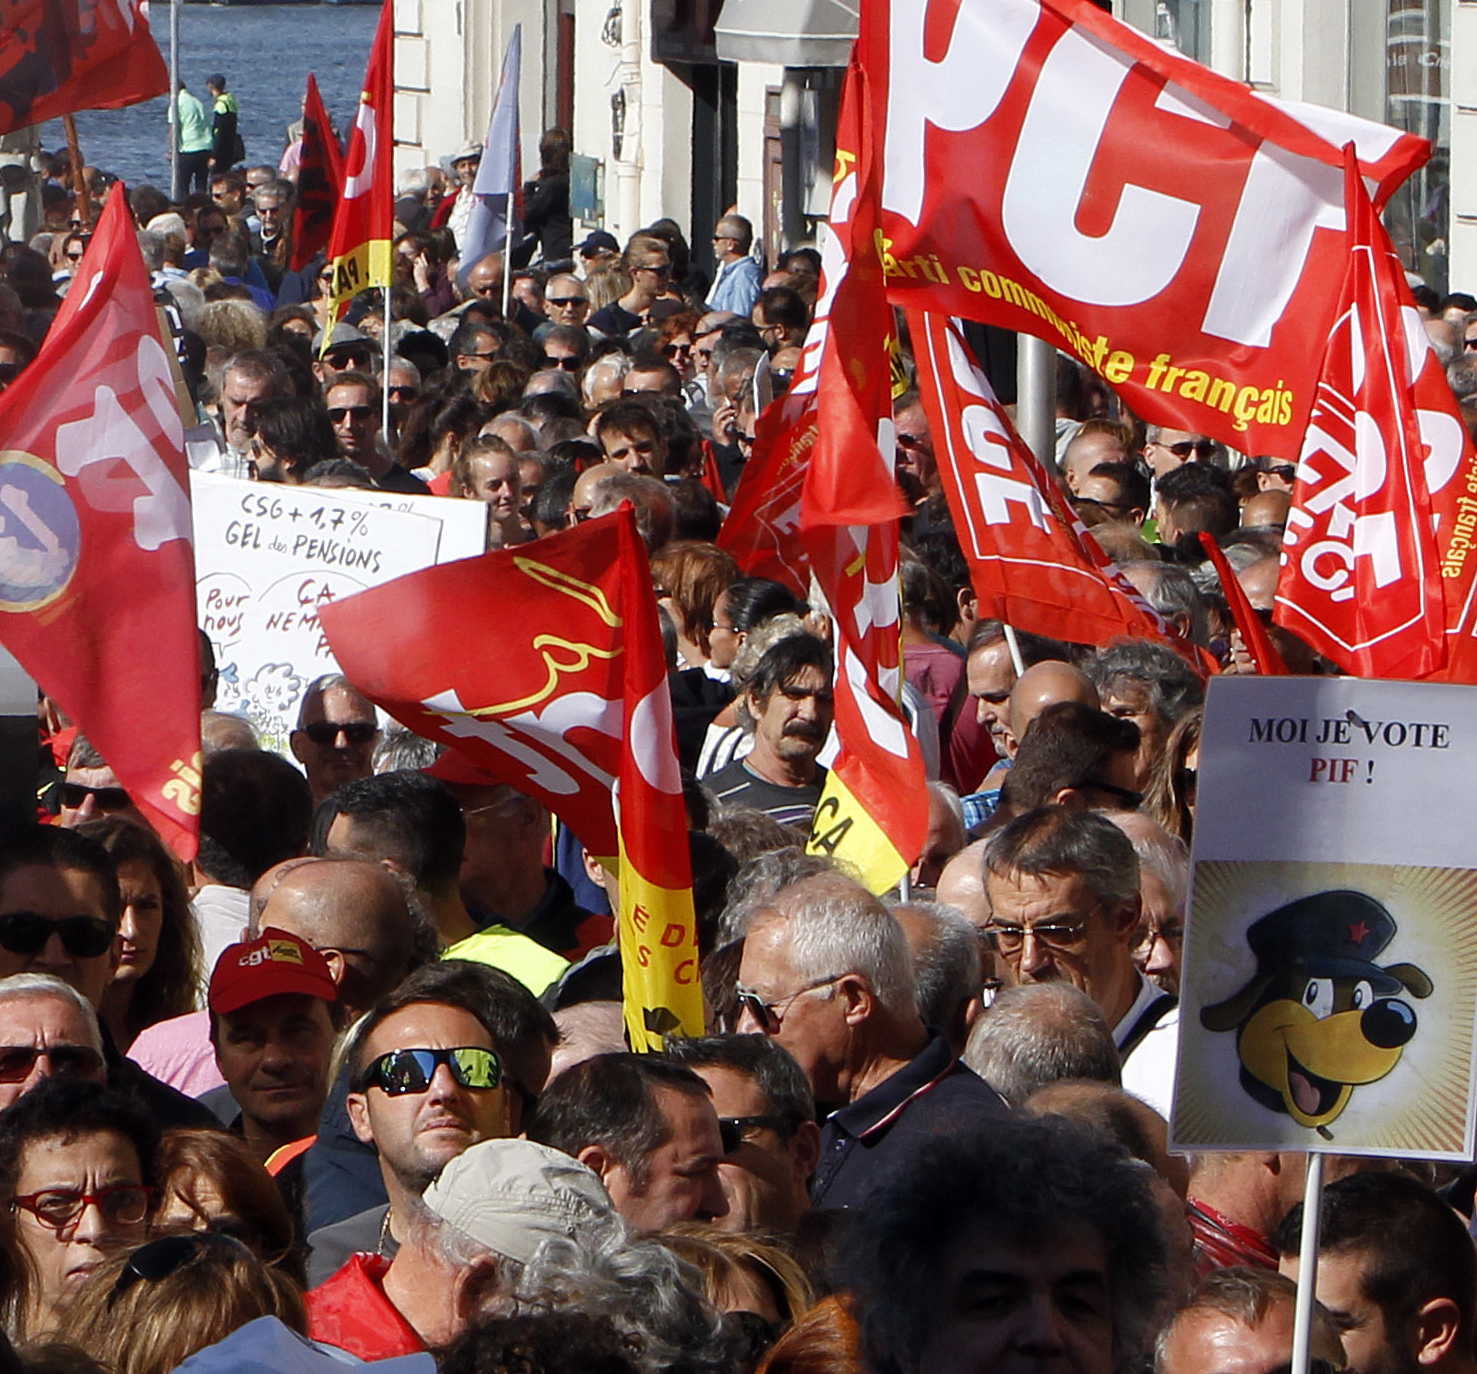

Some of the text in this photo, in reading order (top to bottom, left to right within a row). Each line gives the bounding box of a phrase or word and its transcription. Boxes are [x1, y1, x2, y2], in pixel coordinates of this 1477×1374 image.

[956, 264, 1136, 385] communiste
[1143, 353, 1294, 432] français
[241, 493, 283, 519] CSG
[225, 520, 382, 574] GEL des PENSIONS
[205, 587, 251, 610] Pour
[203, 611, 245, 637] nous
[1248, 716, 1451, 750] MOI JE VOTE
[1308, 756, 1375, 786] PIF !
